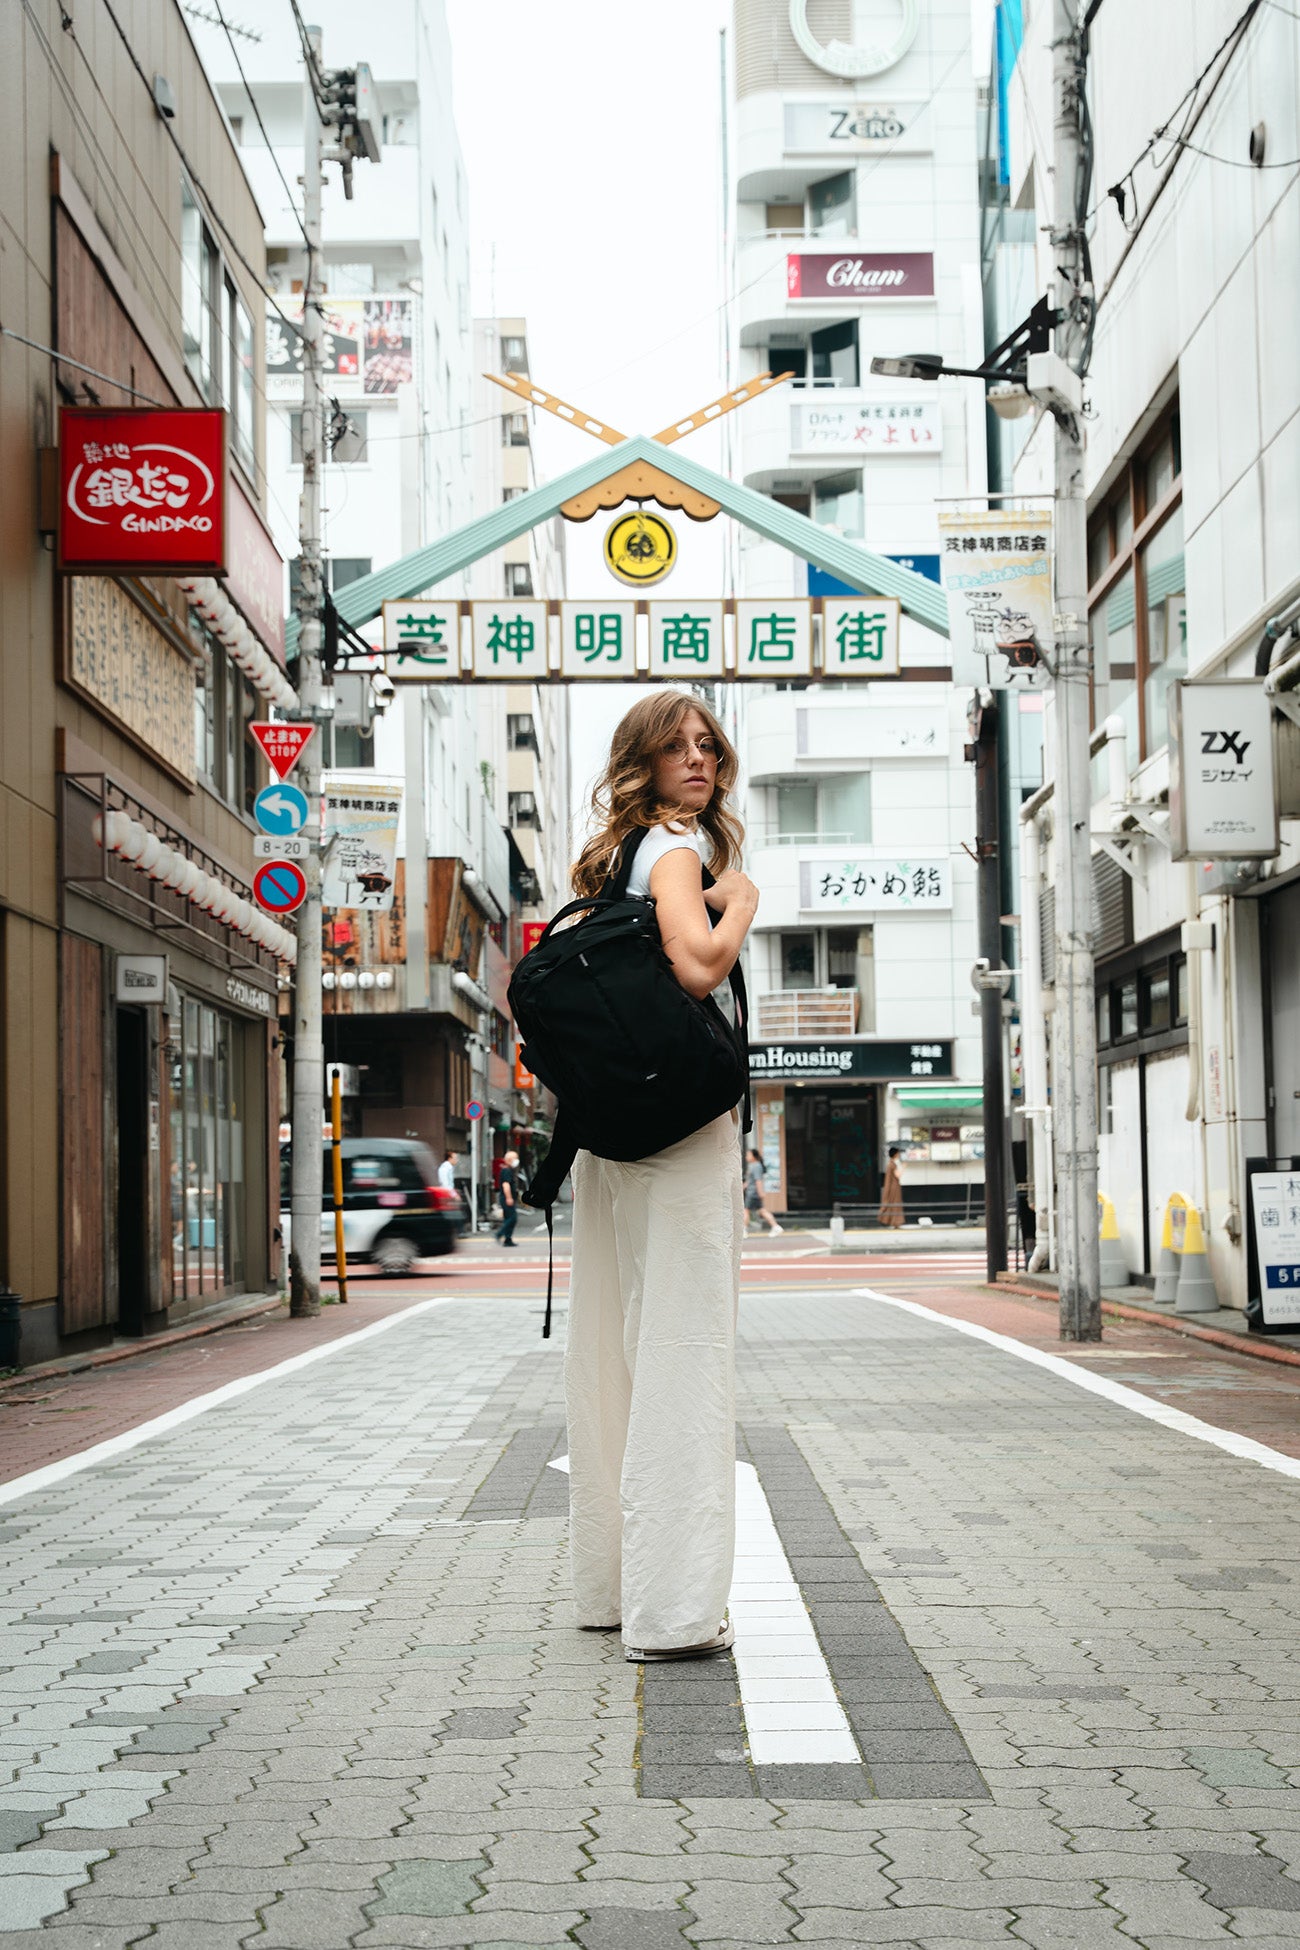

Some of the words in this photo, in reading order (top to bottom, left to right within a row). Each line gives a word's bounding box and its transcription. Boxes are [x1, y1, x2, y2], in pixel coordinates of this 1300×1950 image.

[829, 110, 905, 139] ZERO
[826, 258, 909, 288] Cham
[853, 424, 933, 445] やよい
[83, 441, 131, 464] 築地
[84, 460, 191, 509] 銀だこ
[121, 512, 213, 533] GINDACO
[396, 611, 887, 665] 芝神明商店街
[262, 729, 303, 744] 止まれ
[1201, 730, 1252, 765] ZXY
[269, 745, 298, 758] STOP
[820, 867, 942, 898] おかめ鮨
